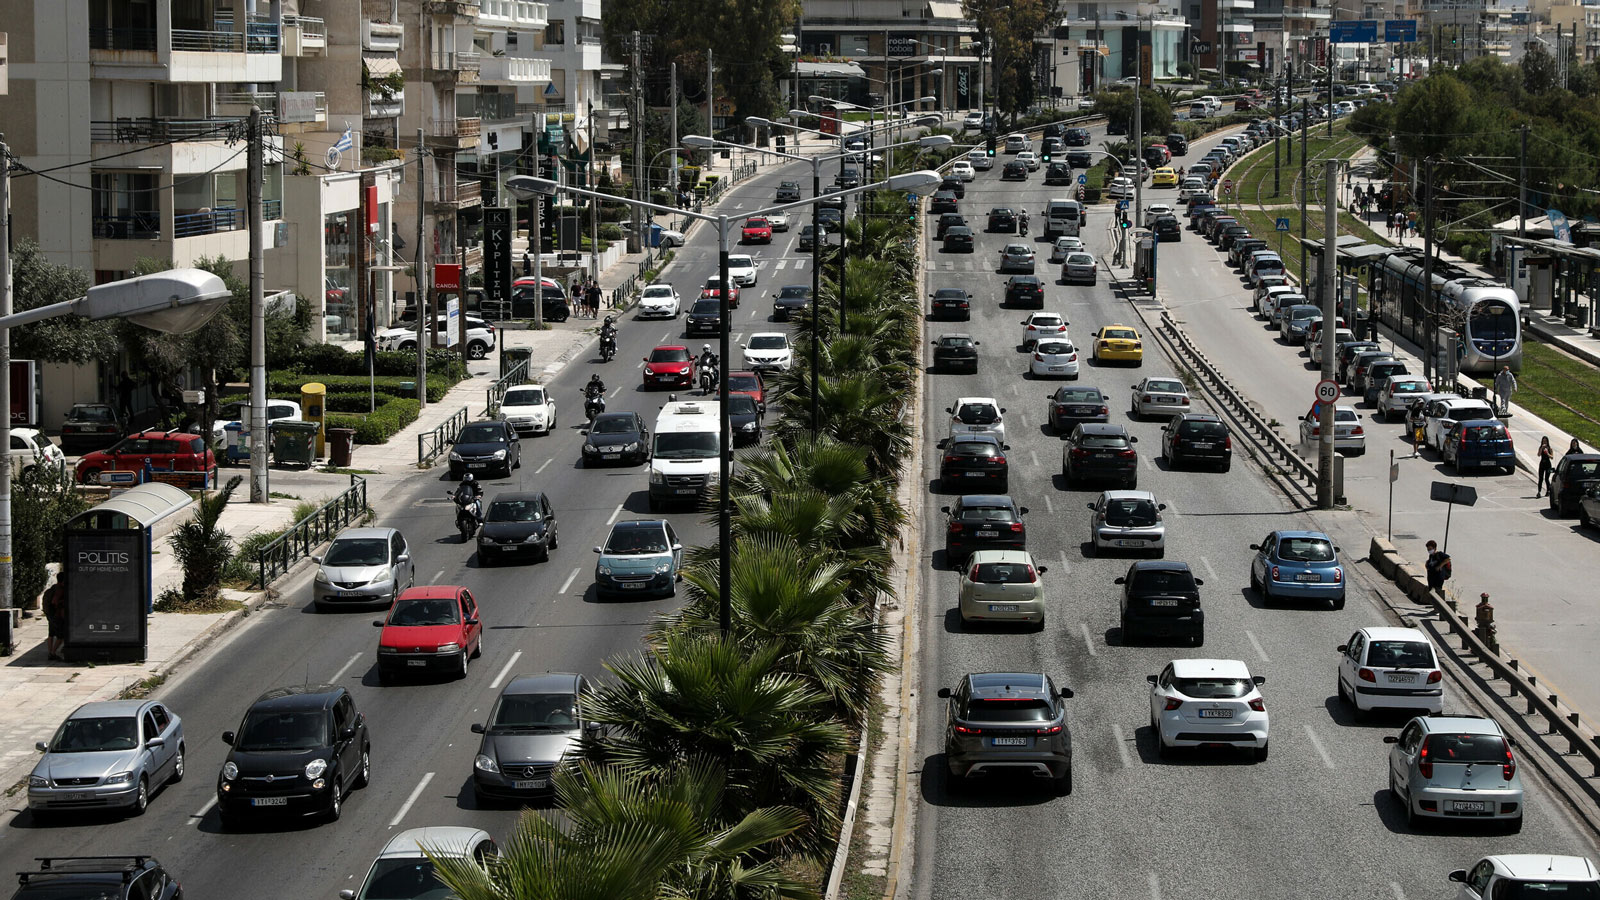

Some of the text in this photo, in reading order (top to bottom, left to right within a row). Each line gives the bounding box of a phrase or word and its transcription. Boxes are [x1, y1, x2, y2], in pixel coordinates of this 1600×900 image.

[888, 45, 913, 53] bobois
[1320, 386, 1335, 397] 60
[79, 552, 128, 563] POLITIS
